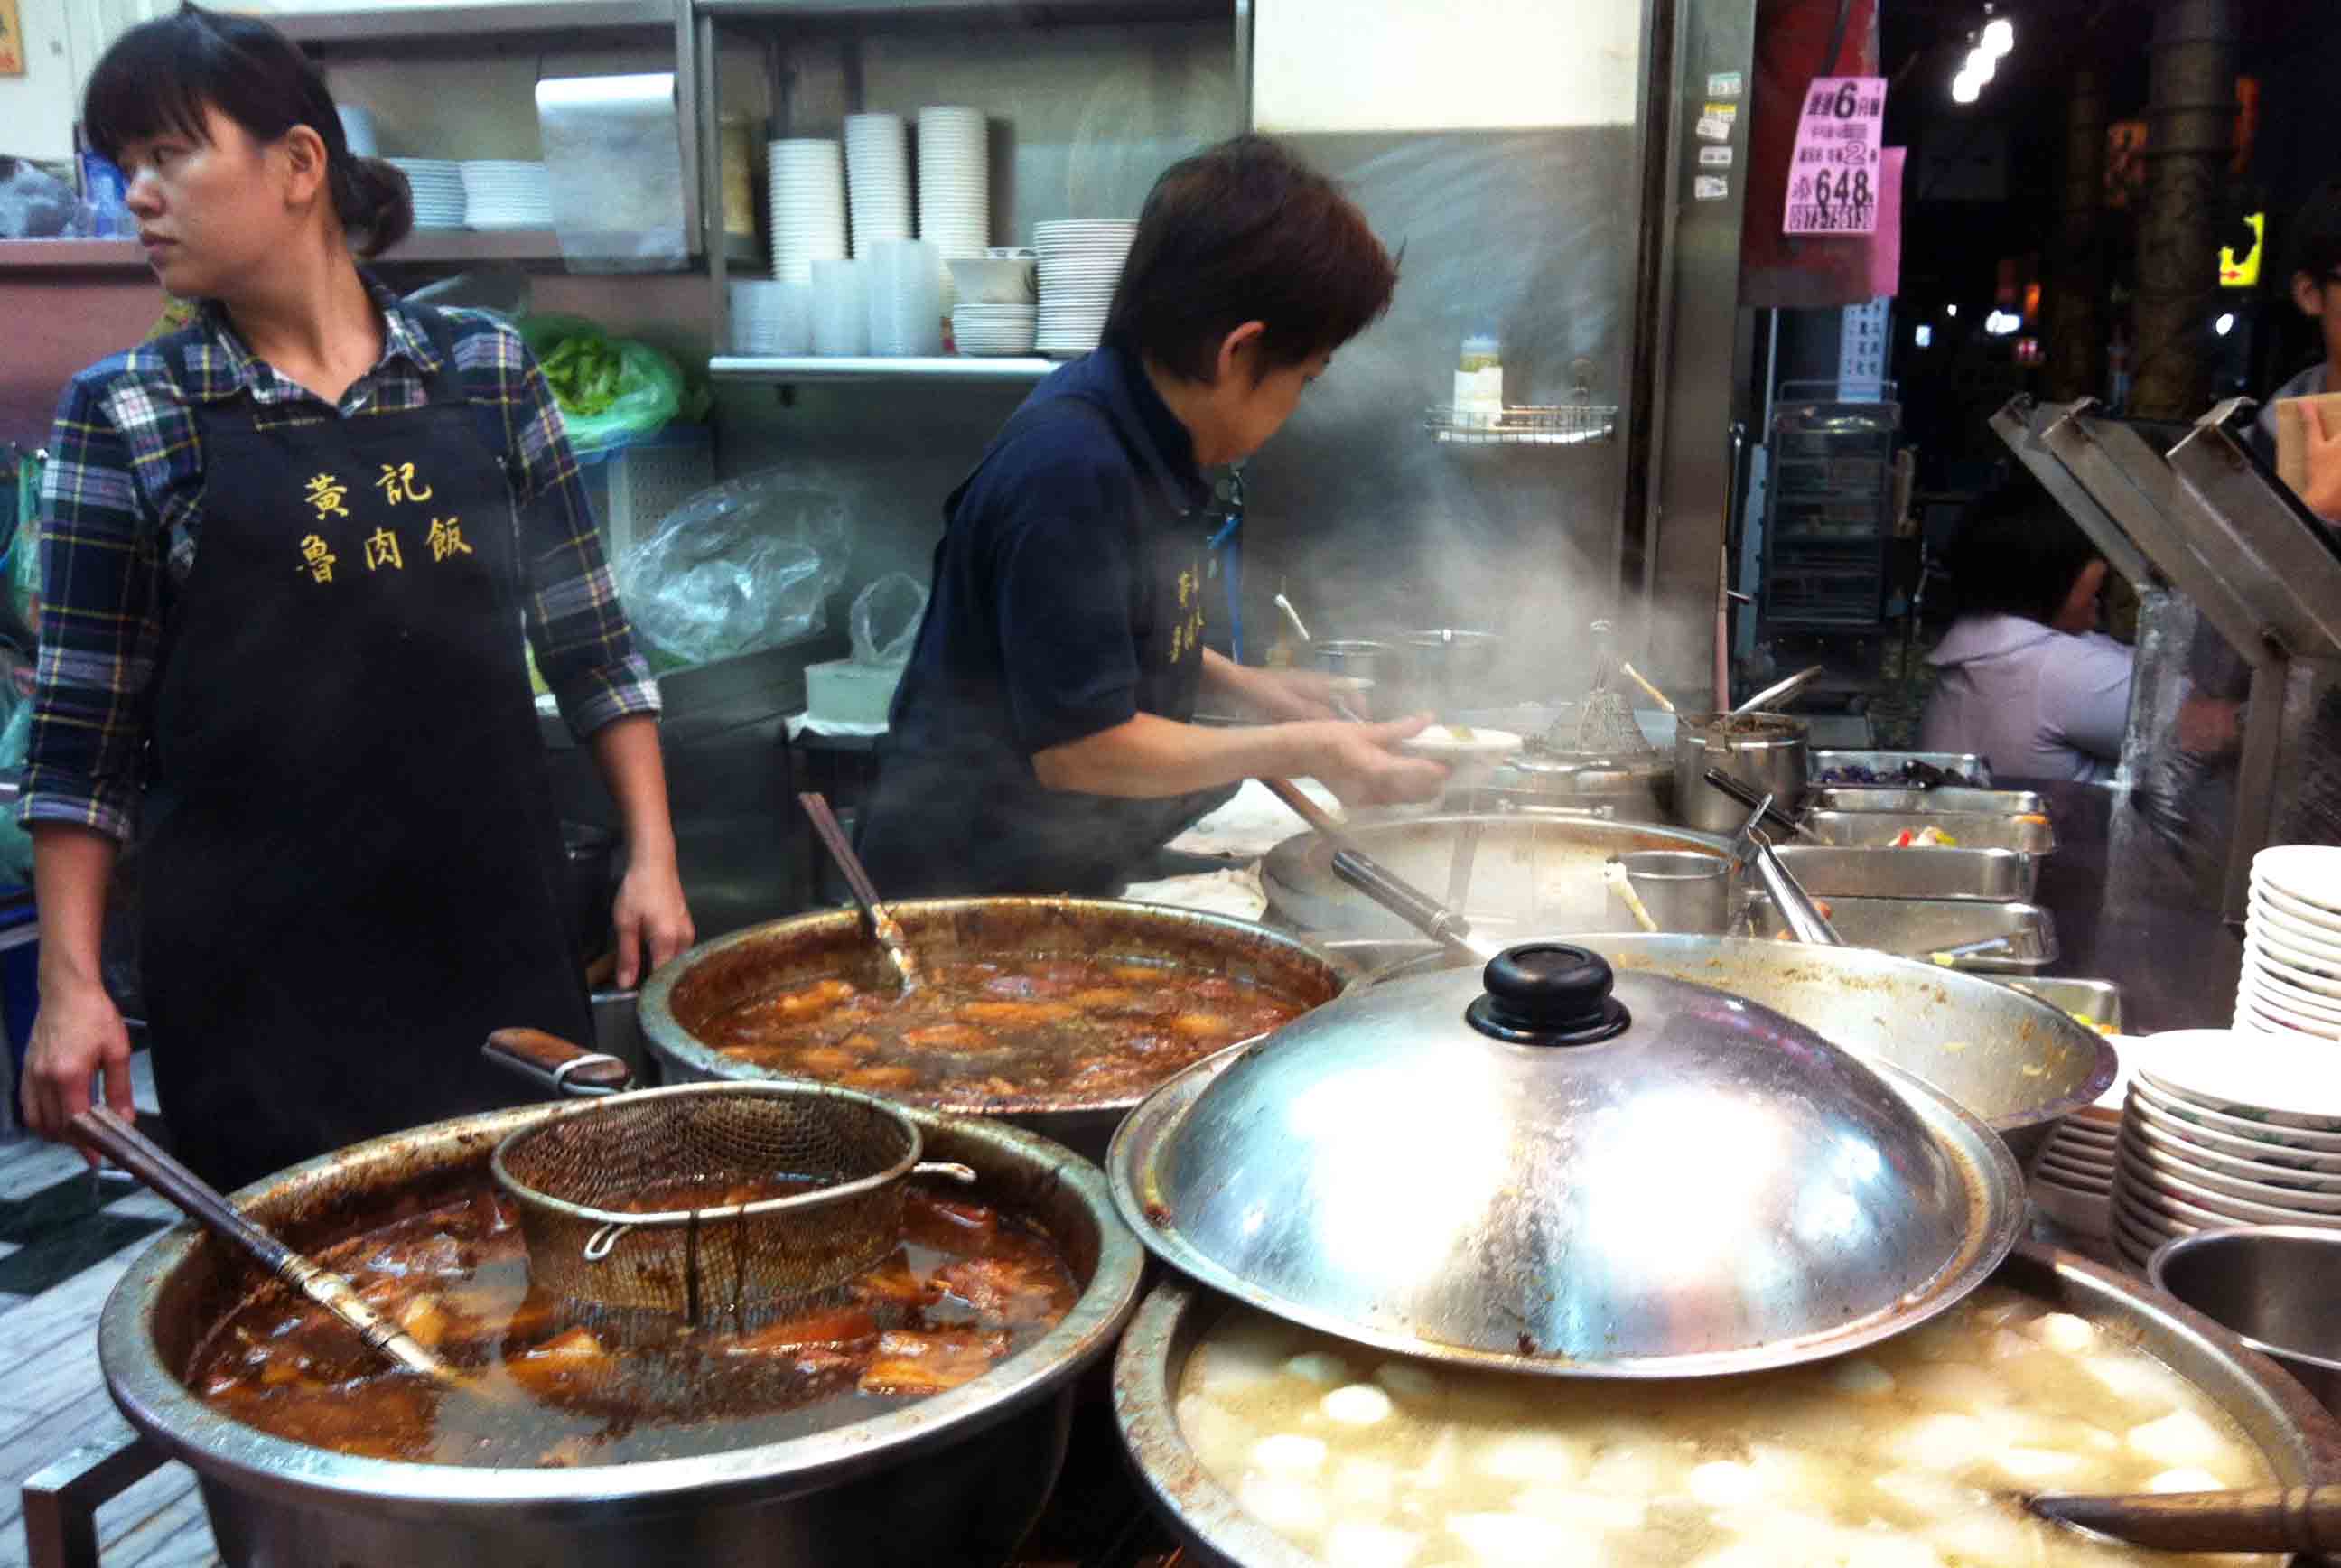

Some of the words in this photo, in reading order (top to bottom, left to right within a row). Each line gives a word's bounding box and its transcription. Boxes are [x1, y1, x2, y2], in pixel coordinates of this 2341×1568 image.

[1833, 81, 1858, 118] 6
[1815, 168, 1868, 207] 648
[304, 462, 434, 521] 黃記
[295, 516, 474, 583] 魯肉飯
